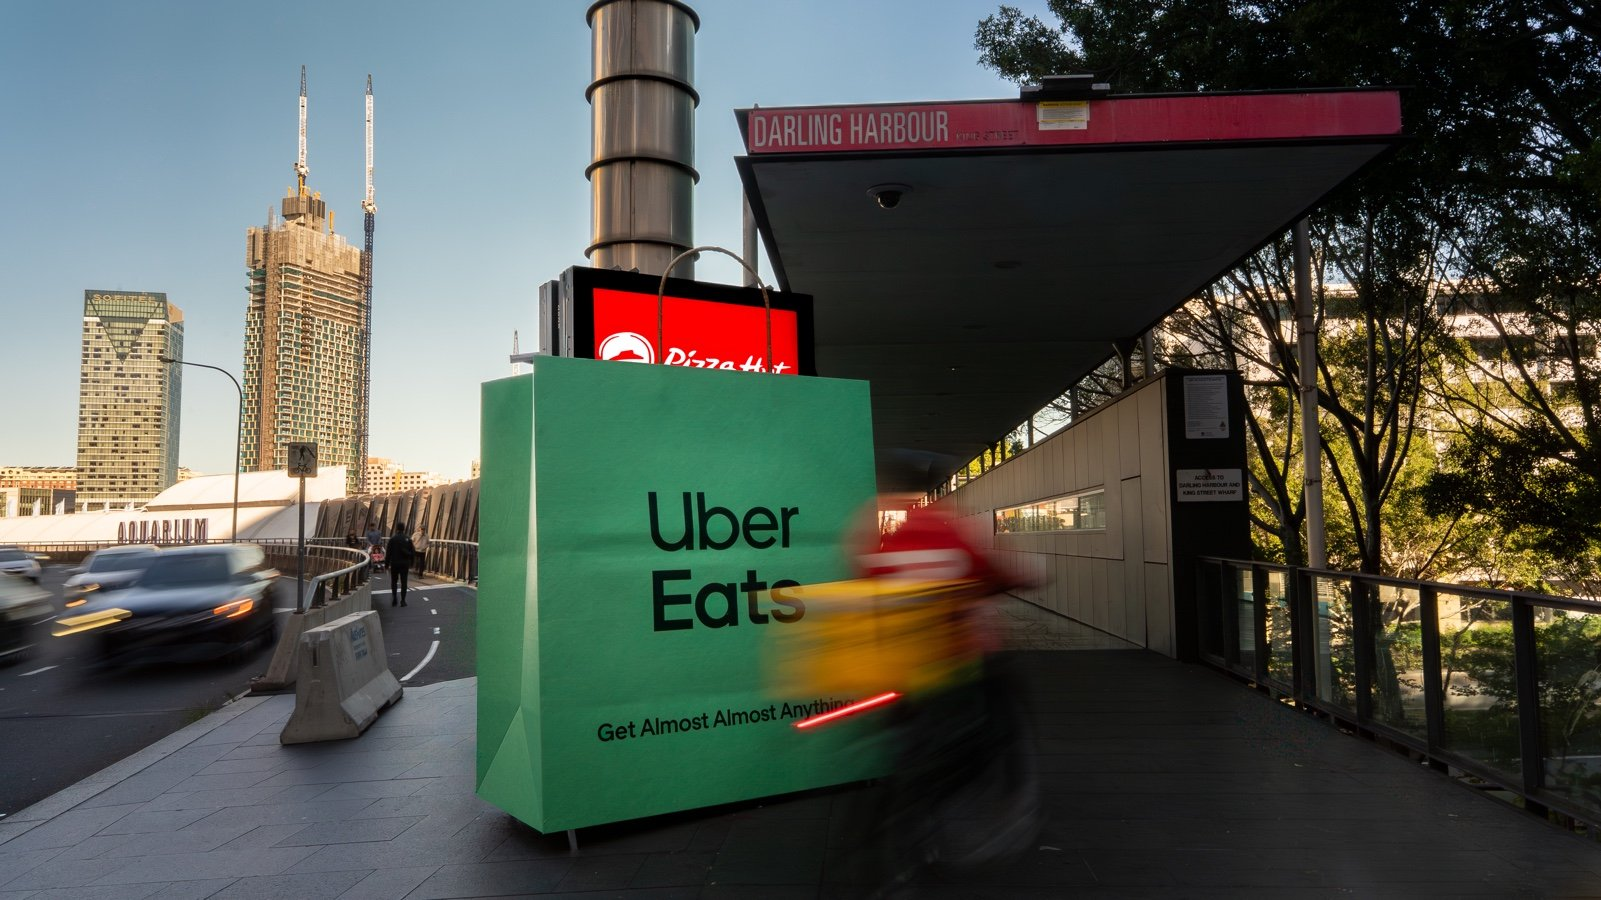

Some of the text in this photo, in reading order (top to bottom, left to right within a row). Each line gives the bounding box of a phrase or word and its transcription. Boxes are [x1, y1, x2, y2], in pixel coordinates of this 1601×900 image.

[754, 111, 949, 147] DARLING HARBOUR
[118, 518, 208, 543] AQUARIUM
[647, 491, 799, 552] Uber
[651, 569, 806, 631] Eats
[597, 720, 637, 742] Get
[640, 712, 709, 737] Almost
[713, 705, 776, 728] Almost
